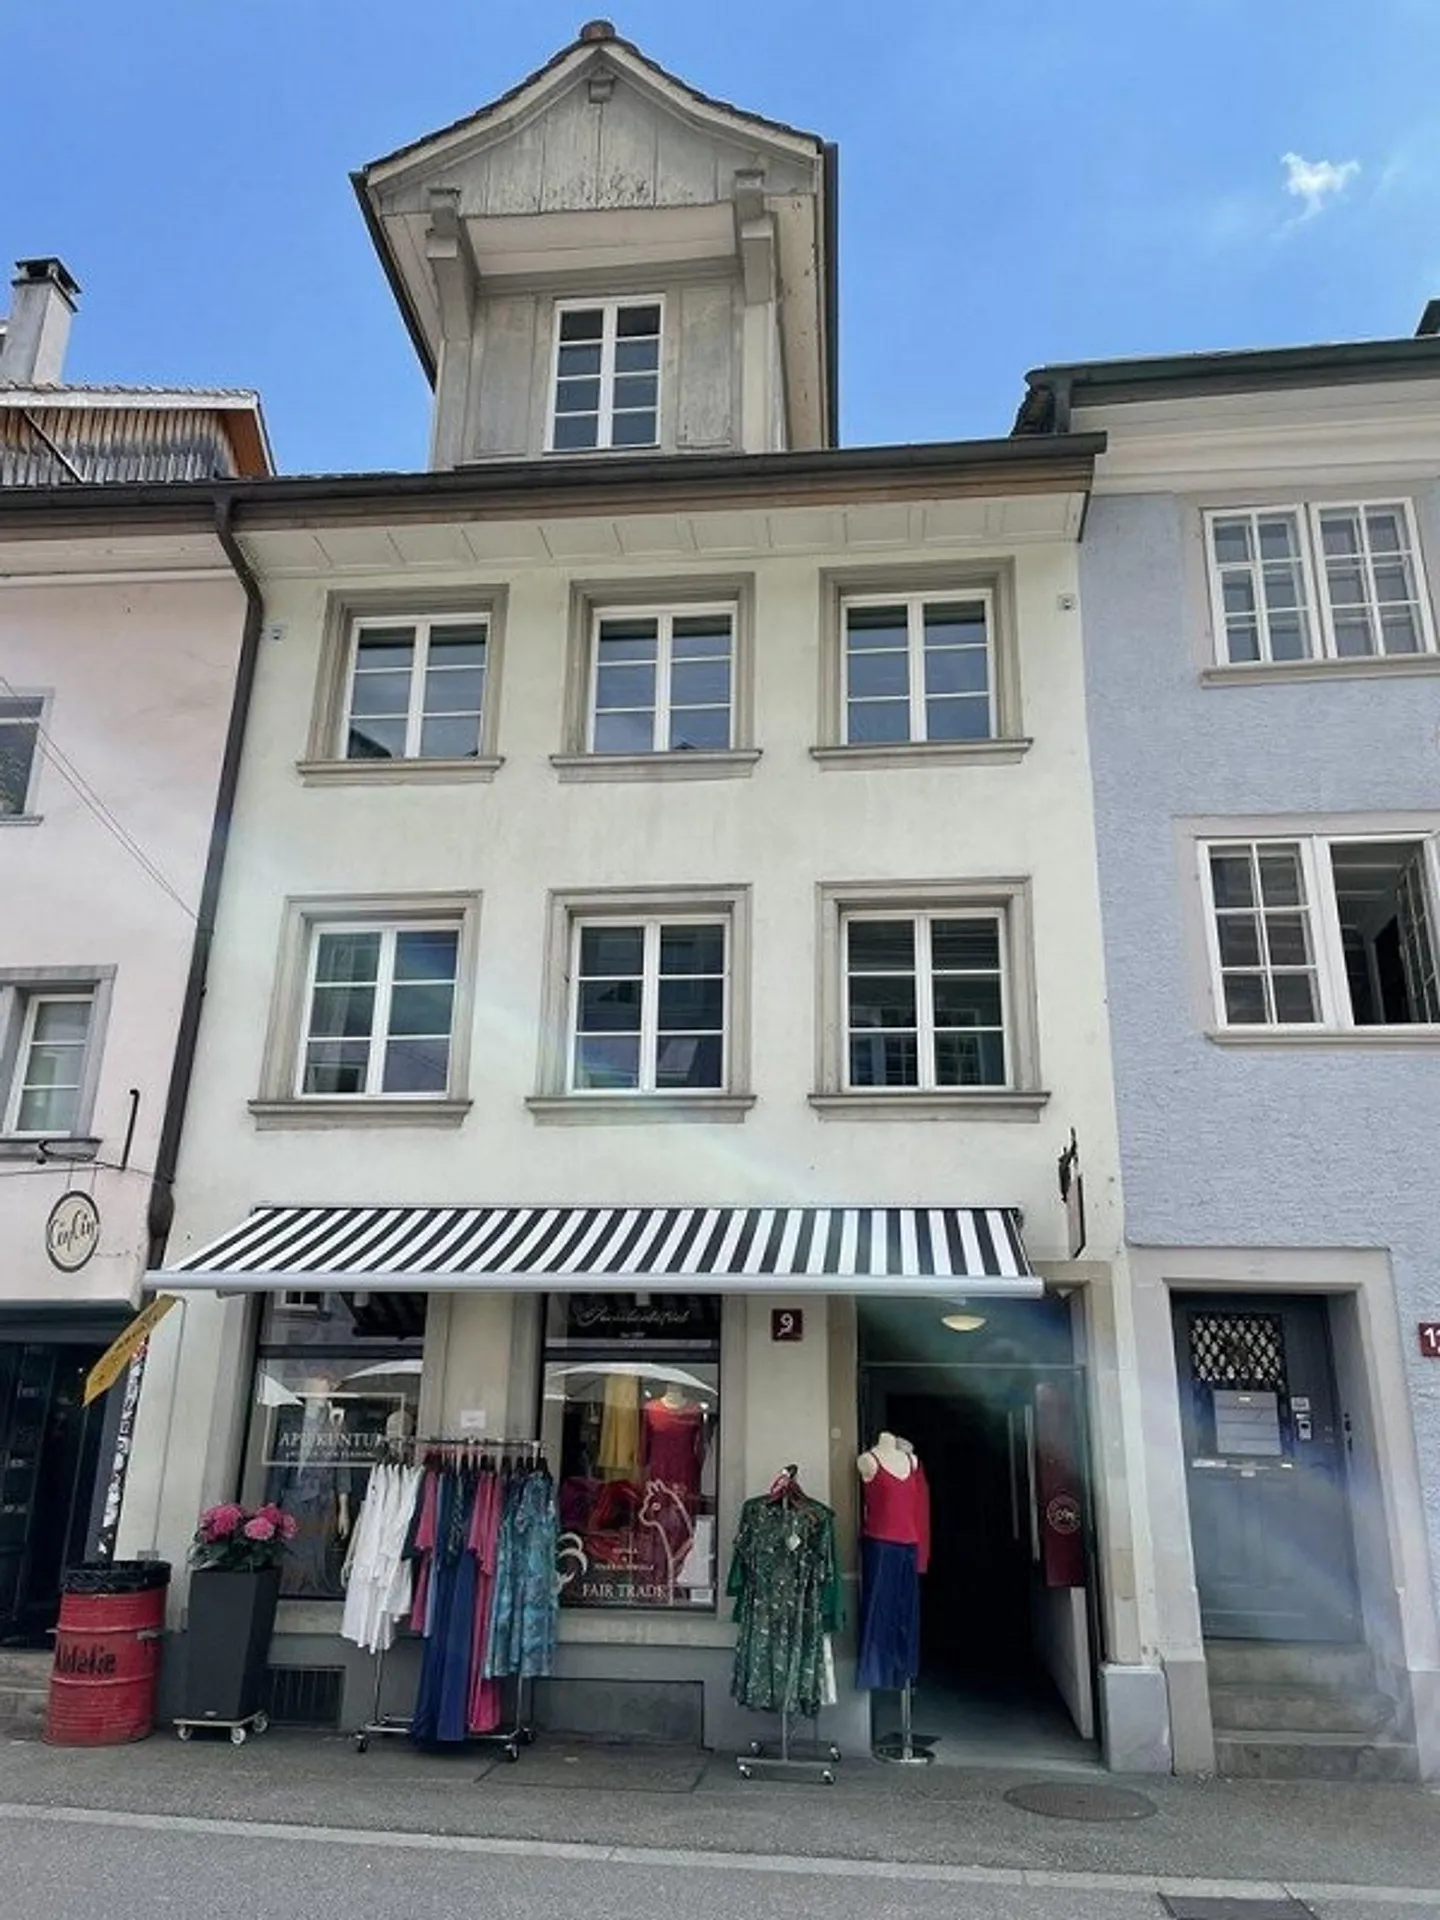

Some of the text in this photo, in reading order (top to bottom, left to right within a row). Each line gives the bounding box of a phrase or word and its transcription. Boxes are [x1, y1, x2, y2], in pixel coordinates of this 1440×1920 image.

[776, 1312, 794, 1337] 9
[582, 1583, 667, 1598] FAIR TRADE
